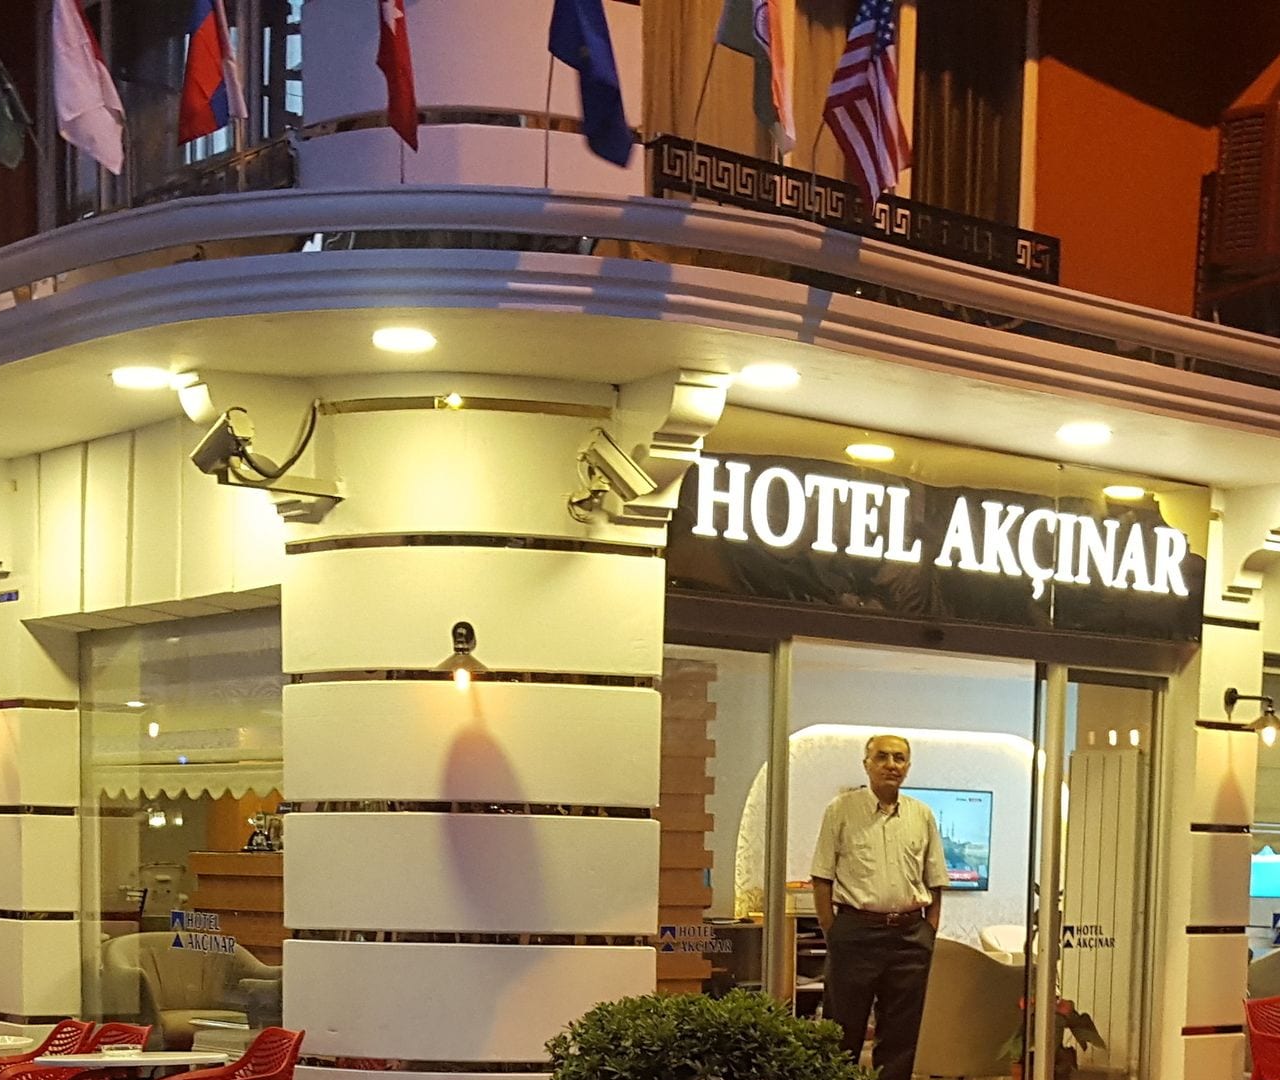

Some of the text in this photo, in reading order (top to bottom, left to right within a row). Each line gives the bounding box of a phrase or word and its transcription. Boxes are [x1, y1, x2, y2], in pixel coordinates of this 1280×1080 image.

[691, 456, 1189, 599] HOTEL AKÇINAR
[186, 911, 221, 931] HOTEL
[1076, 925, 1104, 936] HOTEL
[679, 926, 716, 938] HOTEL
[187, 932, 236, 955] AKÇINAR
